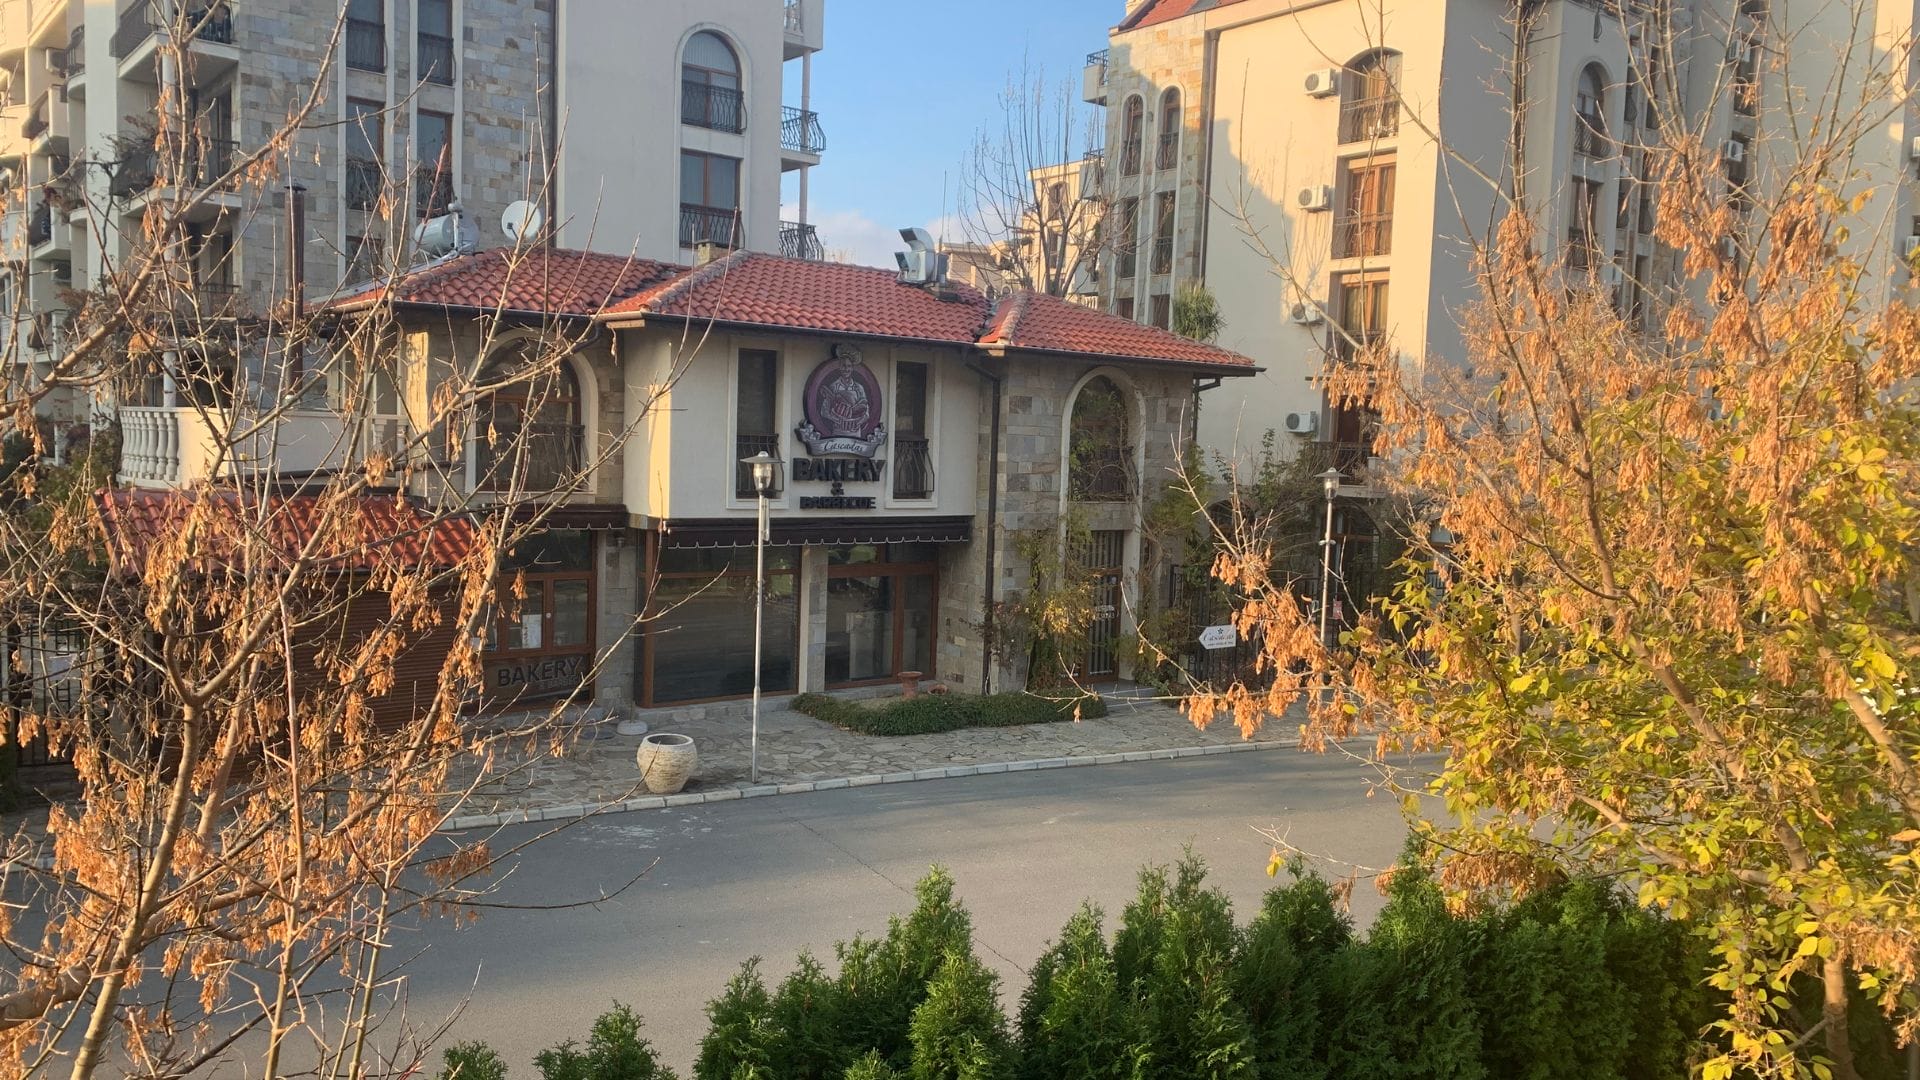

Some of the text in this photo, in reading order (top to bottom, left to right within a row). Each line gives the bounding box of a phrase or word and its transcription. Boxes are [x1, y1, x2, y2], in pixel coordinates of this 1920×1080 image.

[823, 440, 864, 452] Cascadas
[793, 458, 886, 481] BAKERY
[831, 482, 844, 495] &
[498, 656, 583, 687] BAKERY
